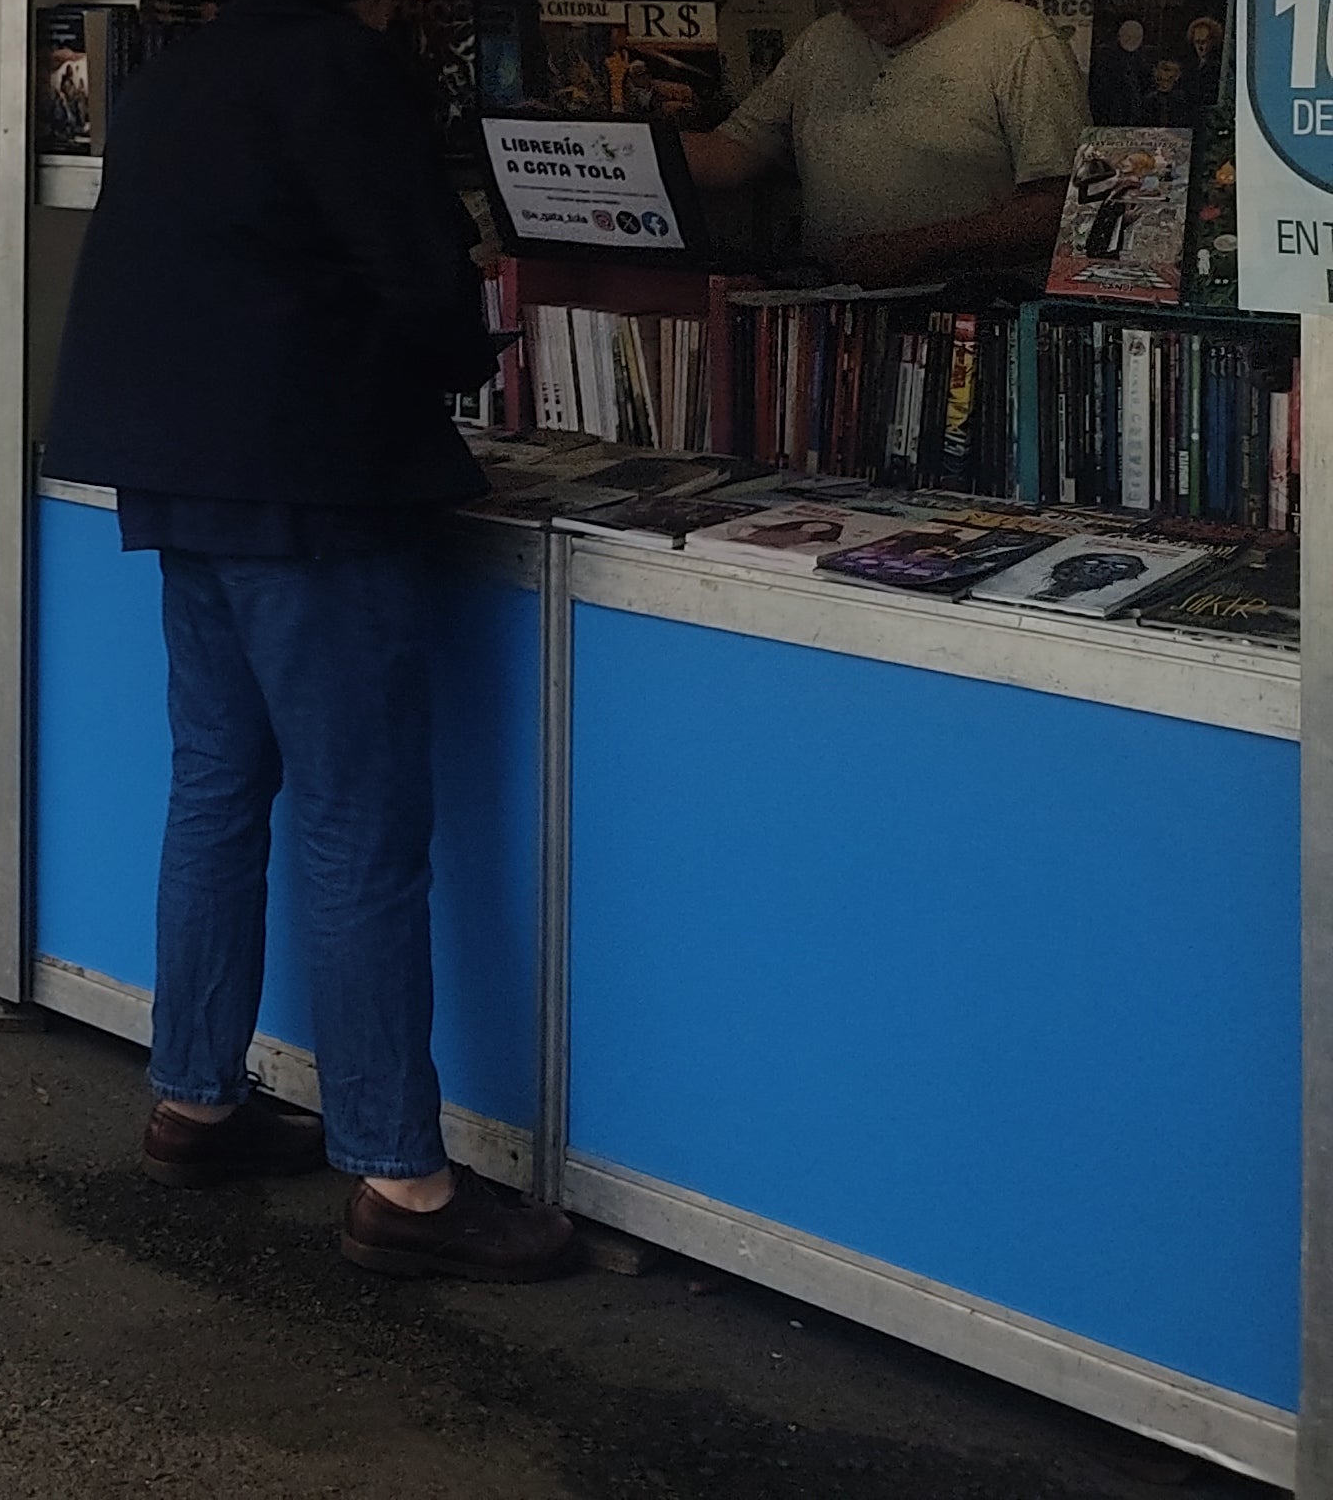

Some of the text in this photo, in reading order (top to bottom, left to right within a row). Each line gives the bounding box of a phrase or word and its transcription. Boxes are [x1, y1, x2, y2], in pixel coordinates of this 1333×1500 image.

[547, 2, 610, 16] CATEDRAL
[501, 137, 585, 157] LIBRERÍA
[507, 159, 626, 182] A GATA TOLA
